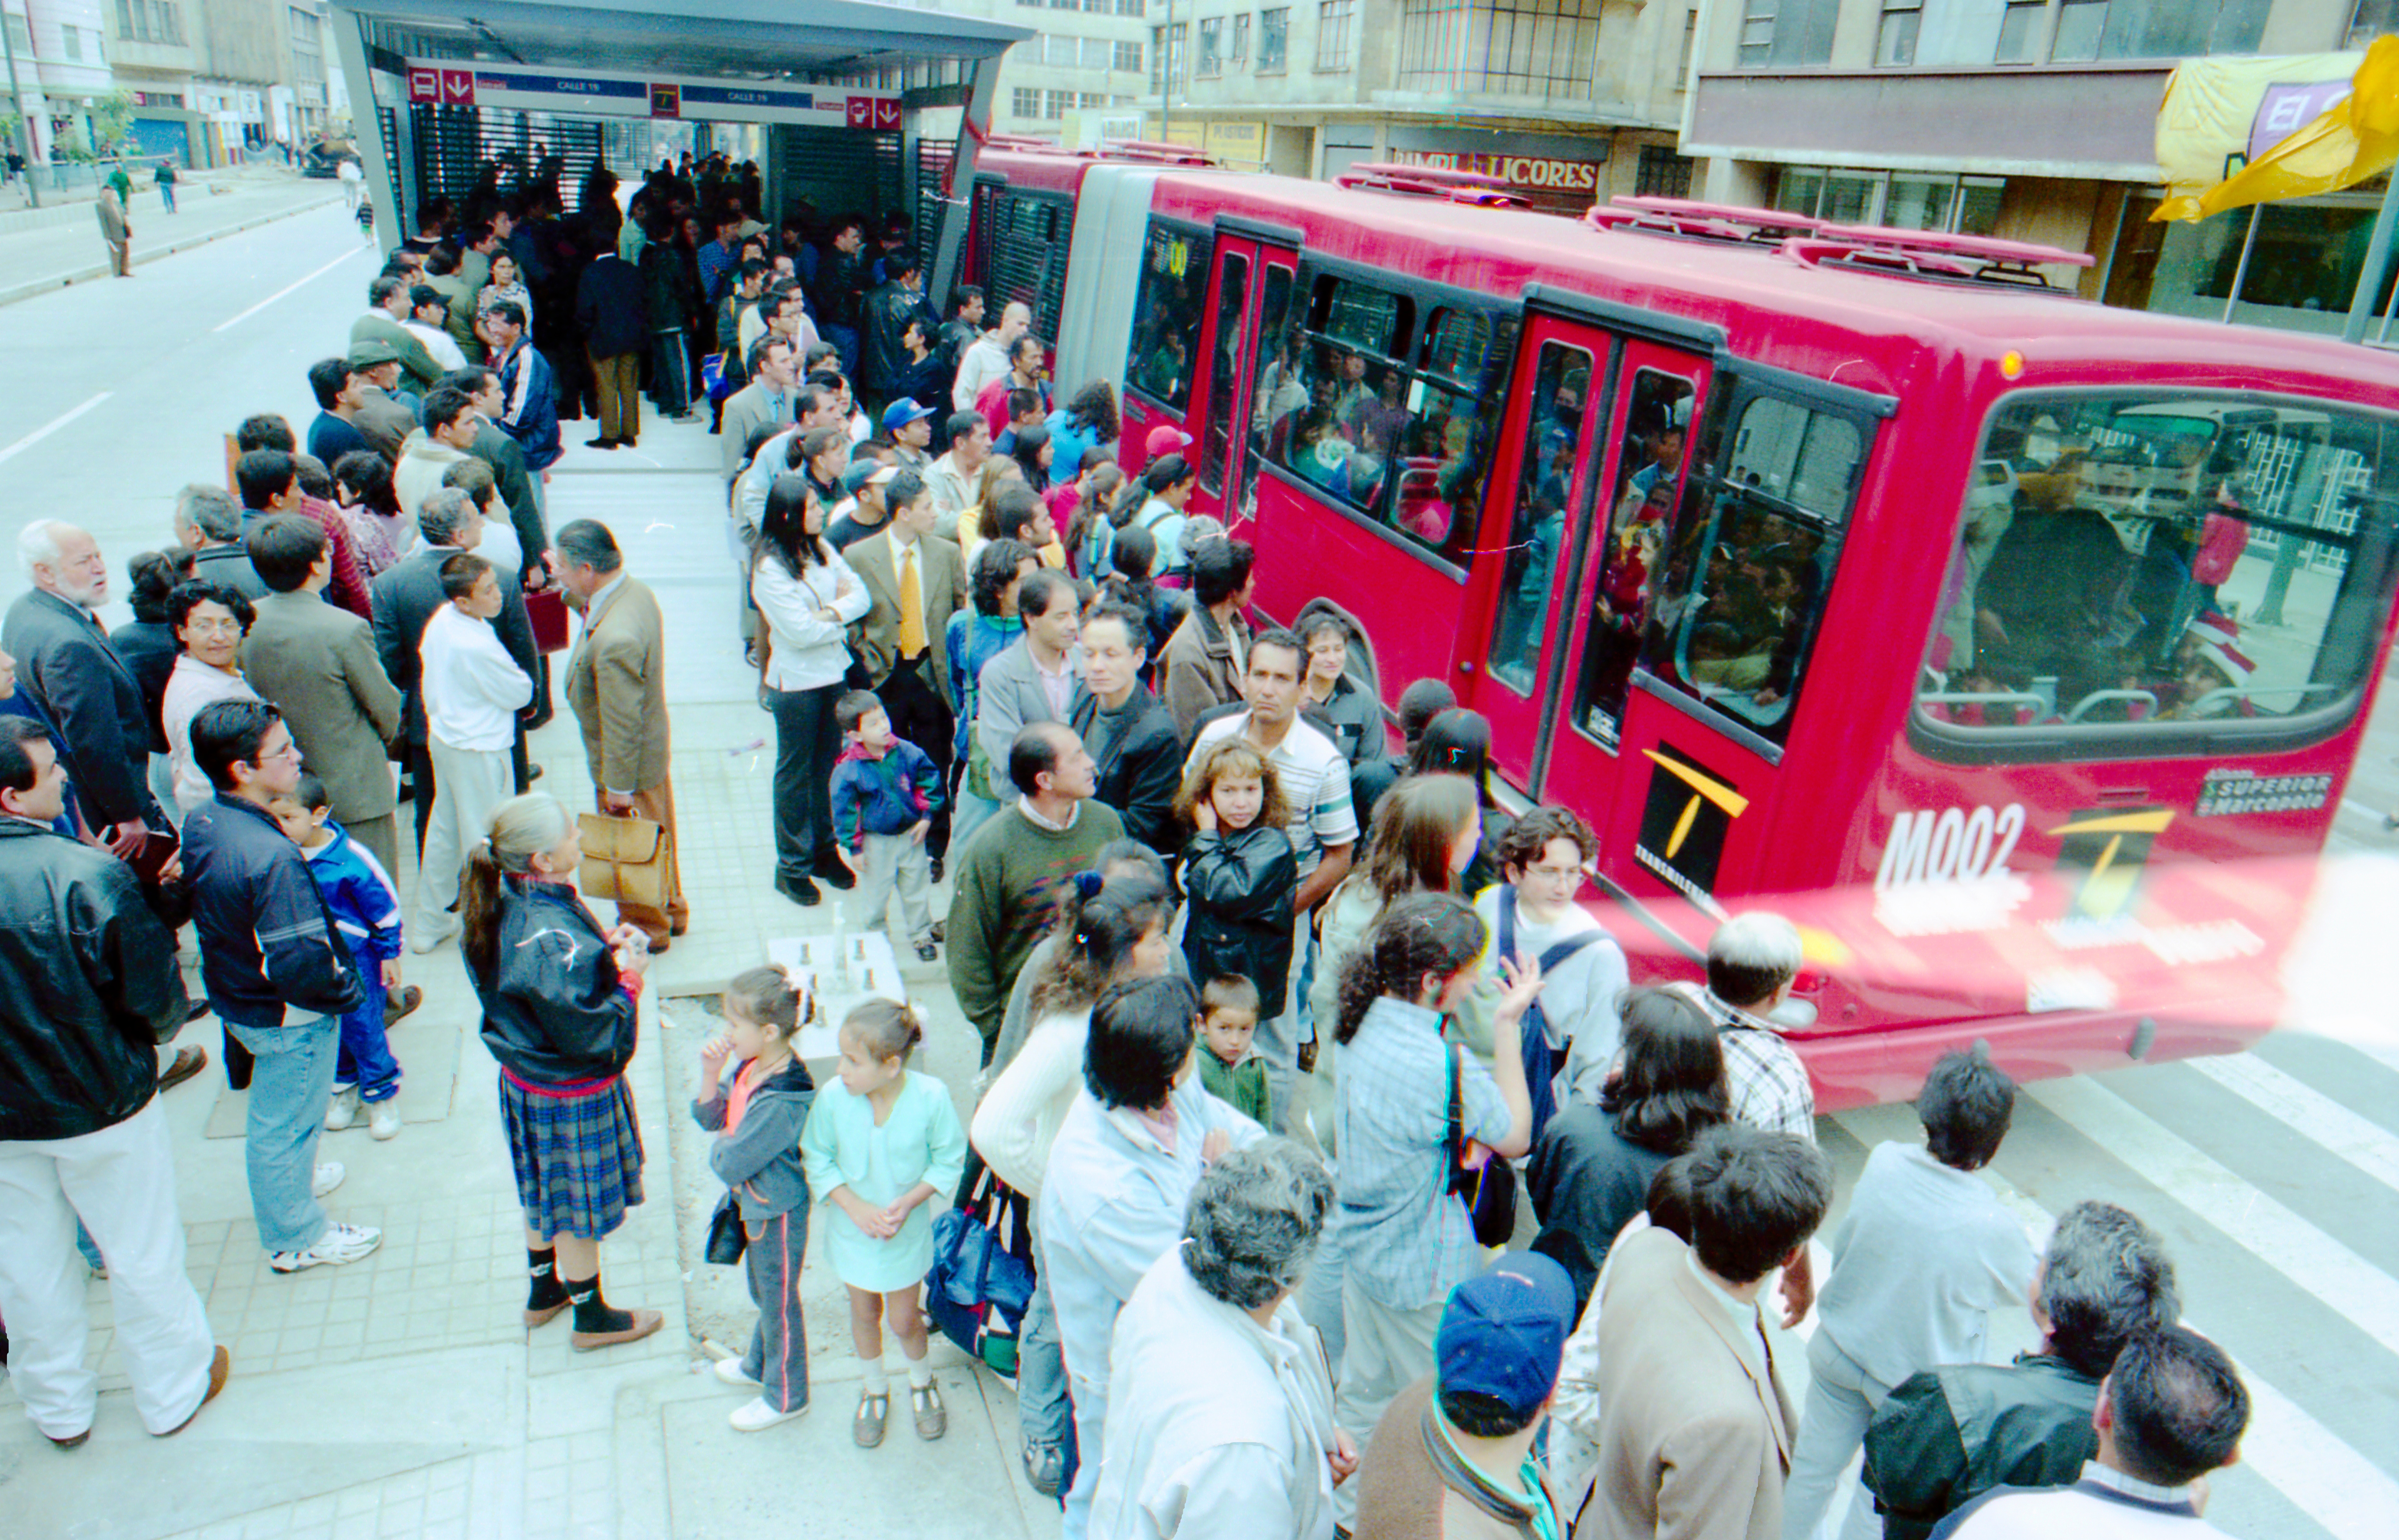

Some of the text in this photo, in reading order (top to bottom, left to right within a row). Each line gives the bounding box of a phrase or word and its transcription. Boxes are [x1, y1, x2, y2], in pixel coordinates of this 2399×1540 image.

[557, 81, 585, 91] CALLE
[1488, 155, 1595, 189] LICORES
[2218, 776, 2331, 797] SUPERIOR
[1873, 803, 2026, 891] M002
